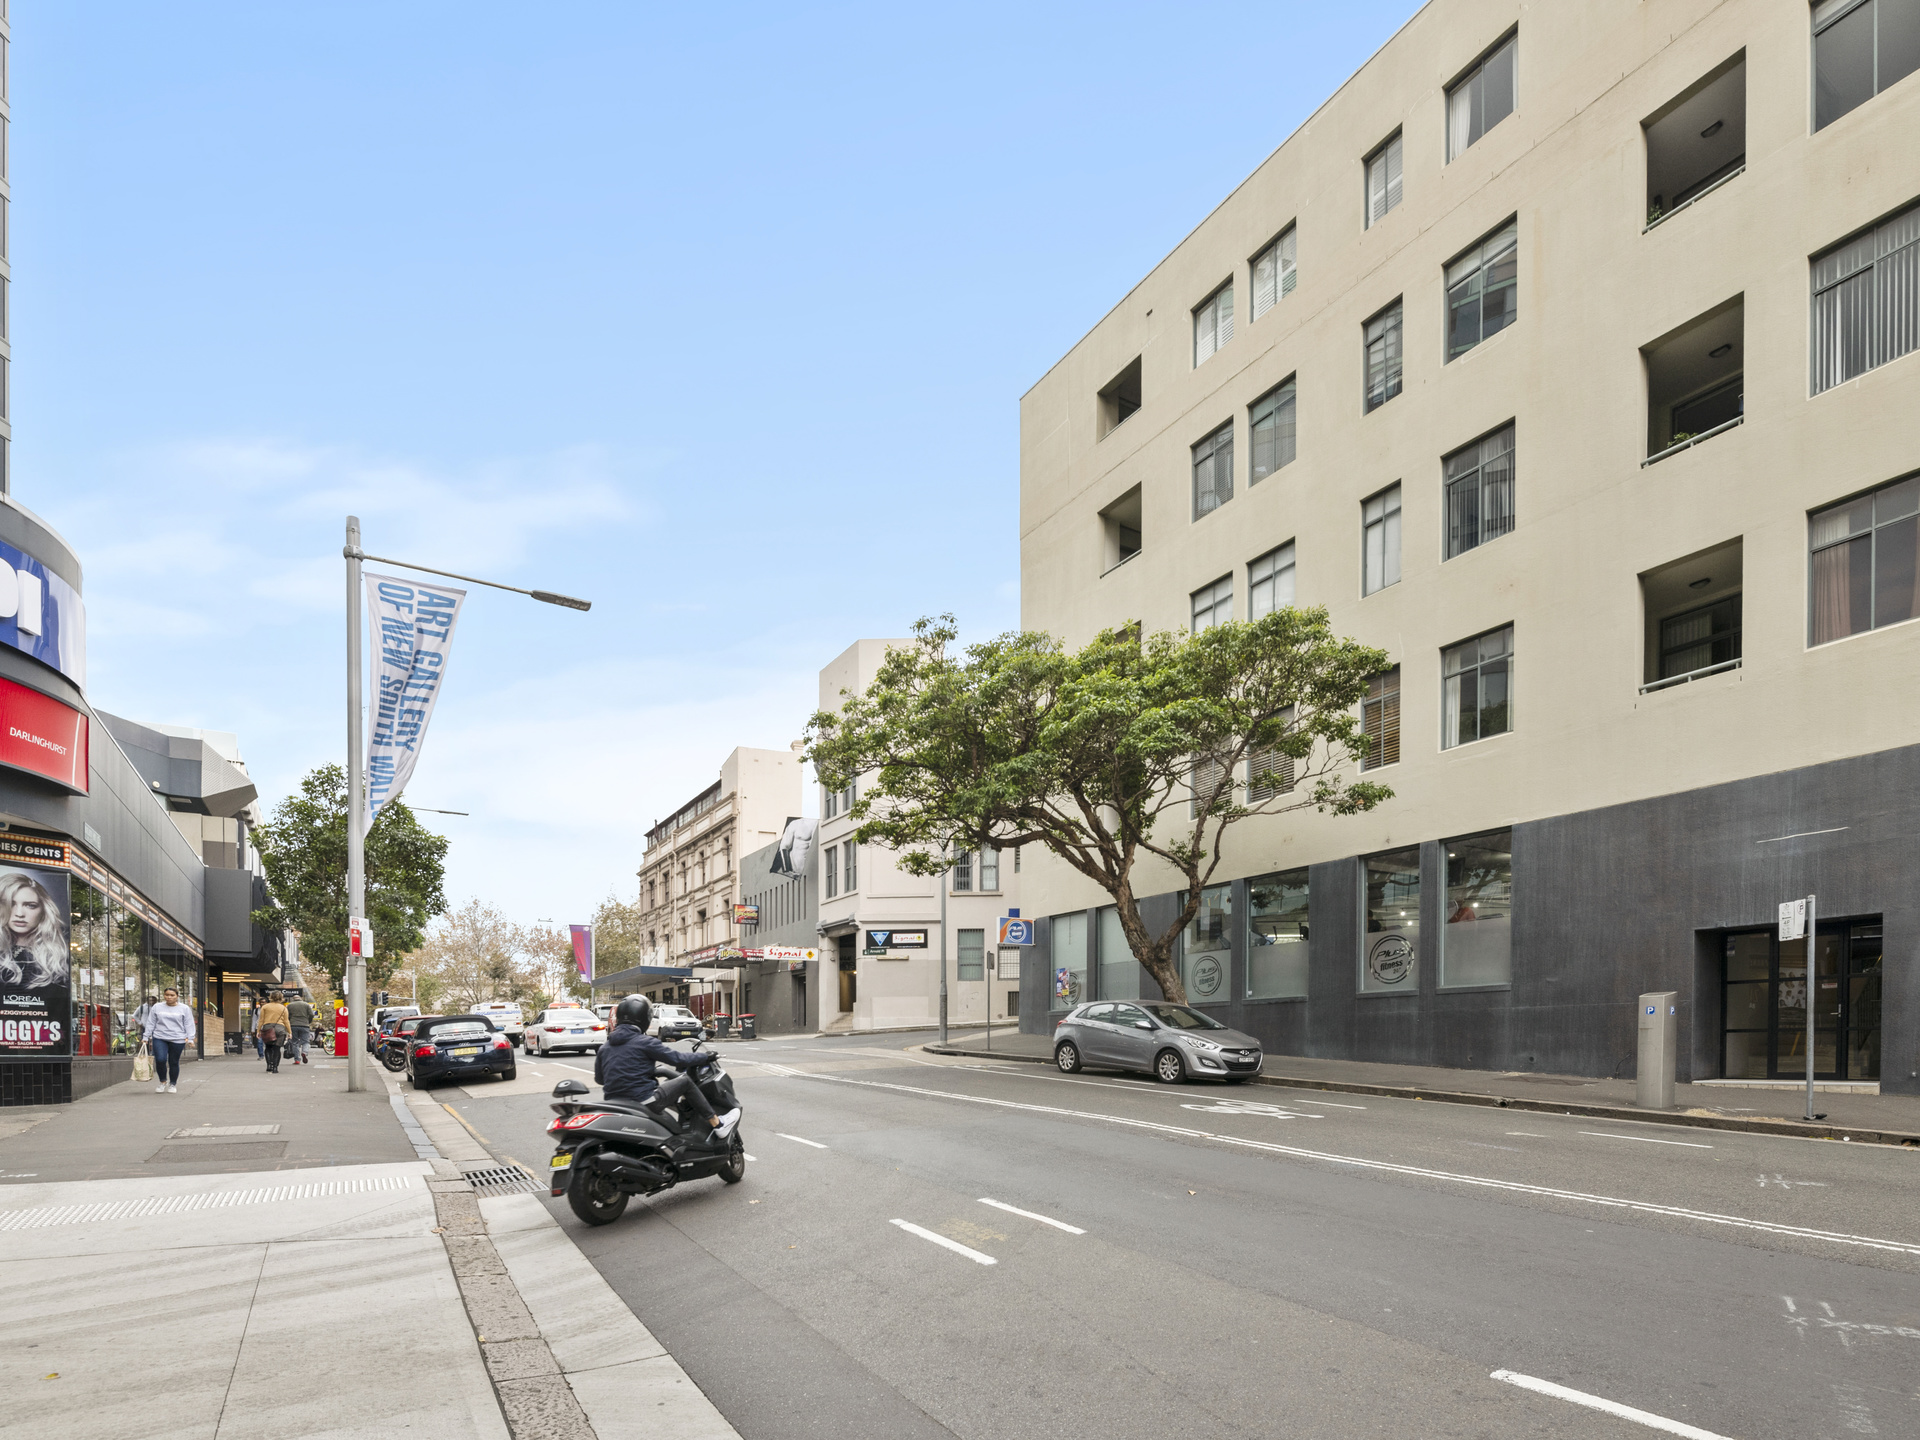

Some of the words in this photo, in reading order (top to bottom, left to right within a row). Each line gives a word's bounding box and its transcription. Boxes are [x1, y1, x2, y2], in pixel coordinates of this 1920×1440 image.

[377, 582, 415, 615] OF
[414, 590, 457, 643] ART
[381, 616, 415, 672] NEW
[372, 674, 404, 747] SOUTH
[395, 649, 443, 753] GALLERY
[10, 726, 67, 756] DARLINGHURST
[370, 755, 396, 821] WAL
[25, 845, 61, 858] GENTS
[1380, 960, 1403, 971] fitness
[1647, 1006, 1654, 1015] P
